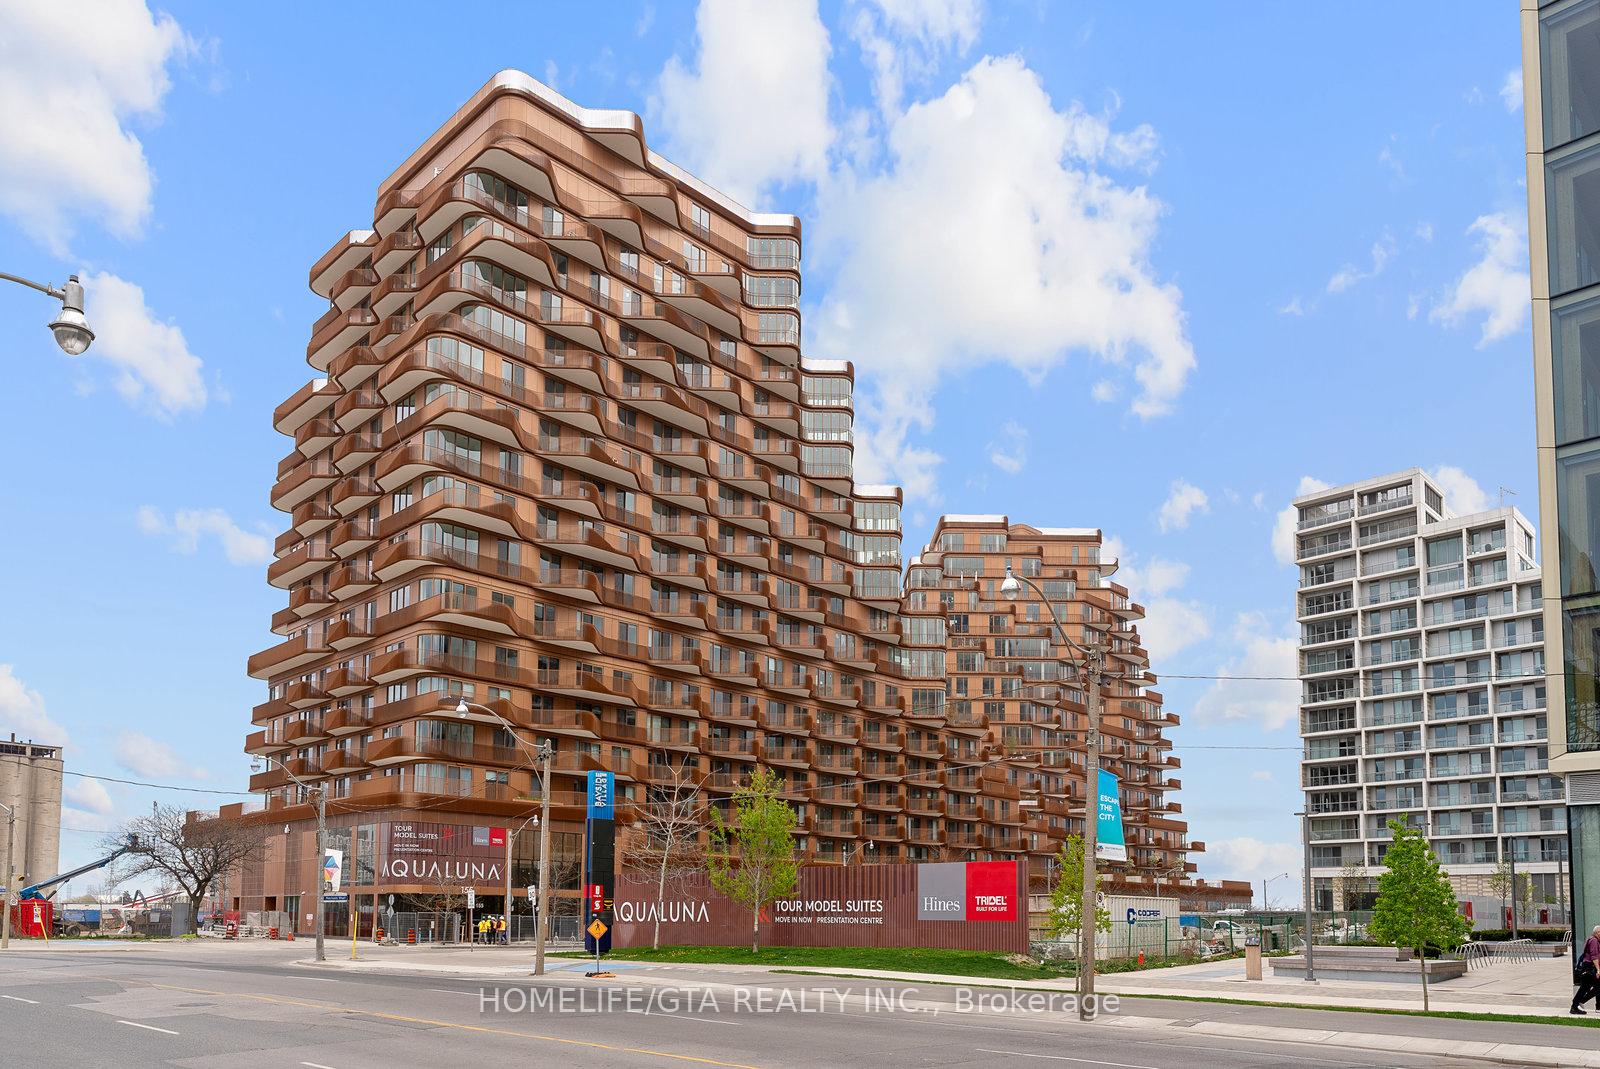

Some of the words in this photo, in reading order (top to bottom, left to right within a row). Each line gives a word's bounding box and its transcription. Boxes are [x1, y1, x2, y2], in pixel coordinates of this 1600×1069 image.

[1100, 804, 1113, 812] THE
[1099, 813, 1115, 821] CITY
[381, 859, 500, 880] AQUALUNA
[774, 900, 802, 912] TOUR
[805, 900, 843, 912] MODEL
[846, 900, 883, 912] SUITES
[923, 895, 961, 912] Hines
[974, 895, 1007, 906] TRIDEL
[775, 916, 790, 924] MOVE
[791, 916, 798, 924] IN
[798, 916, 813, 924] NOW
[816, 916, 859, 924] PRESENTATION
[860, 916, 884, 925] CENTRE
